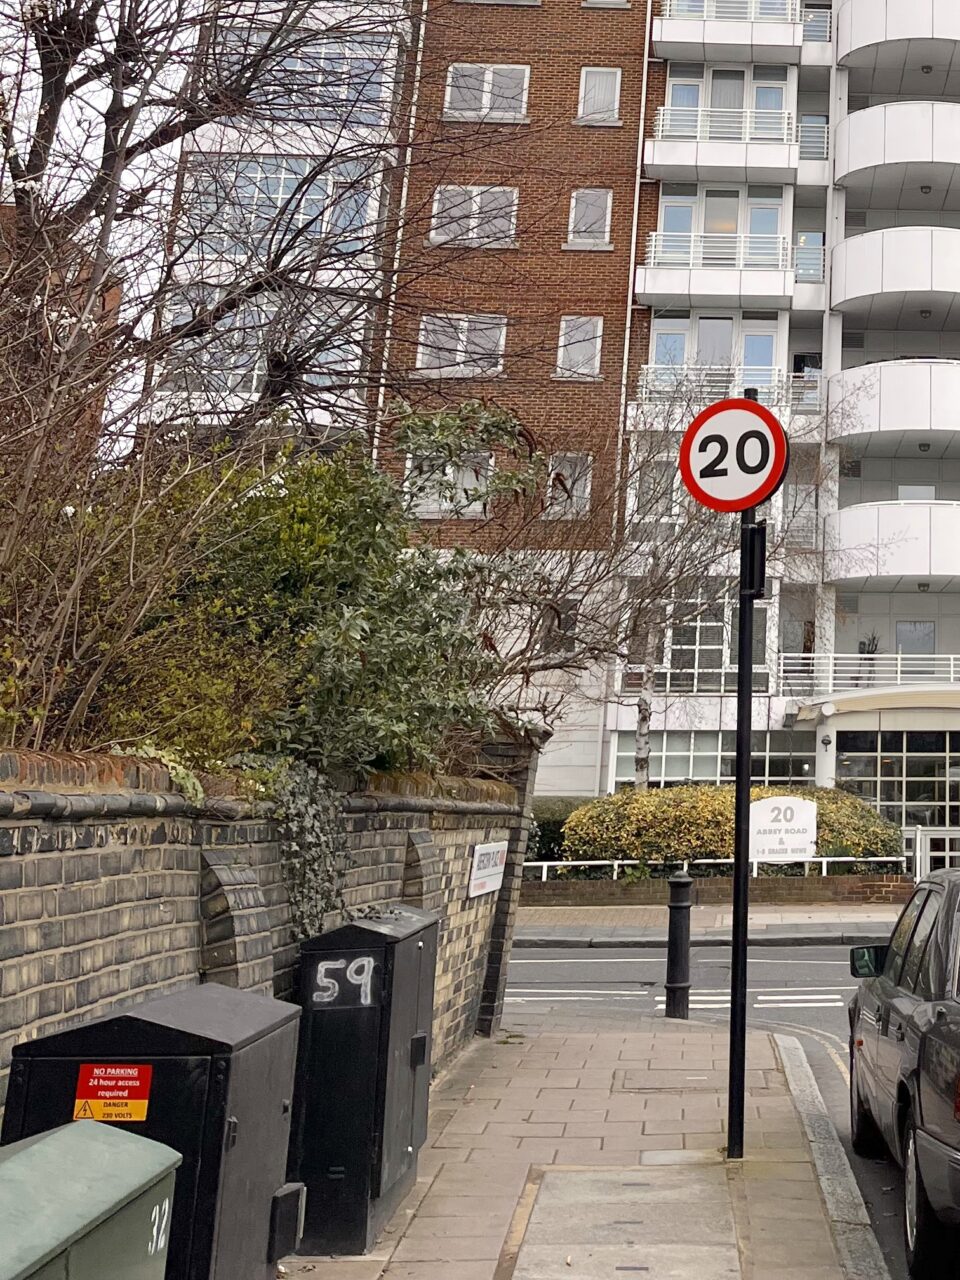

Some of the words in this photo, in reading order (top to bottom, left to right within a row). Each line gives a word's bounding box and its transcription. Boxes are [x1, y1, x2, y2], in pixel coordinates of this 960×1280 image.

[698, 430, 770, 479] 20
[770, 806, 795, 823] 20
[312, 956, 375, 1006] 59
[93, 1068, 105, 1076] NO
[106, 1068, 139, 1076] PARKING
[88, 1078, 98, 1086] 24
[99, 1078, 116, 1086] hour
[97, 1089, 129, 1098] required
[147, 1197, 169, 1255] 32
